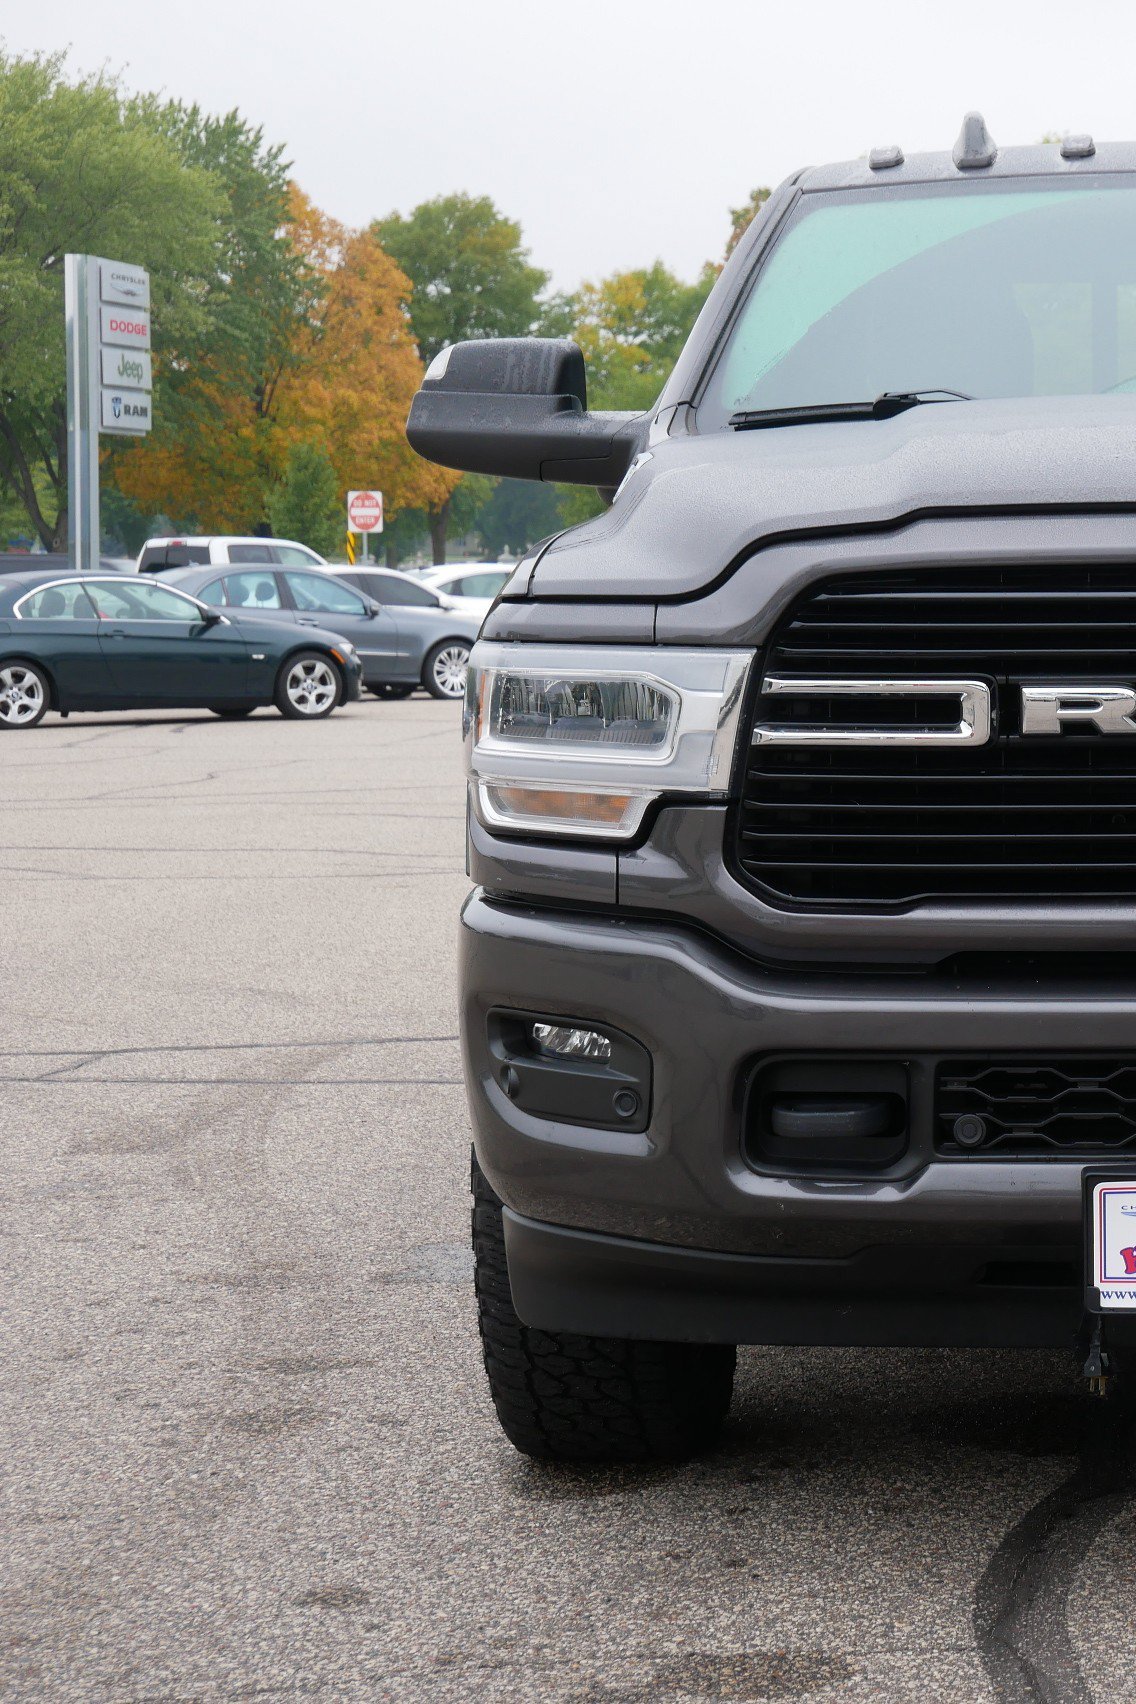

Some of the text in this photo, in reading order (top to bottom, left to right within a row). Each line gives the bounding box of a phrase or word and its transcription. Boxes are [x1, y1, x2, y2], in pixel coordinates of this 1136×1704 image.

[111, 273, 146, 285] CHRYSLER
[110, 320, 147, 336] DODGE
[118, 353, 143, 384] Jeep
[124, 404, 148, 418] RAM
